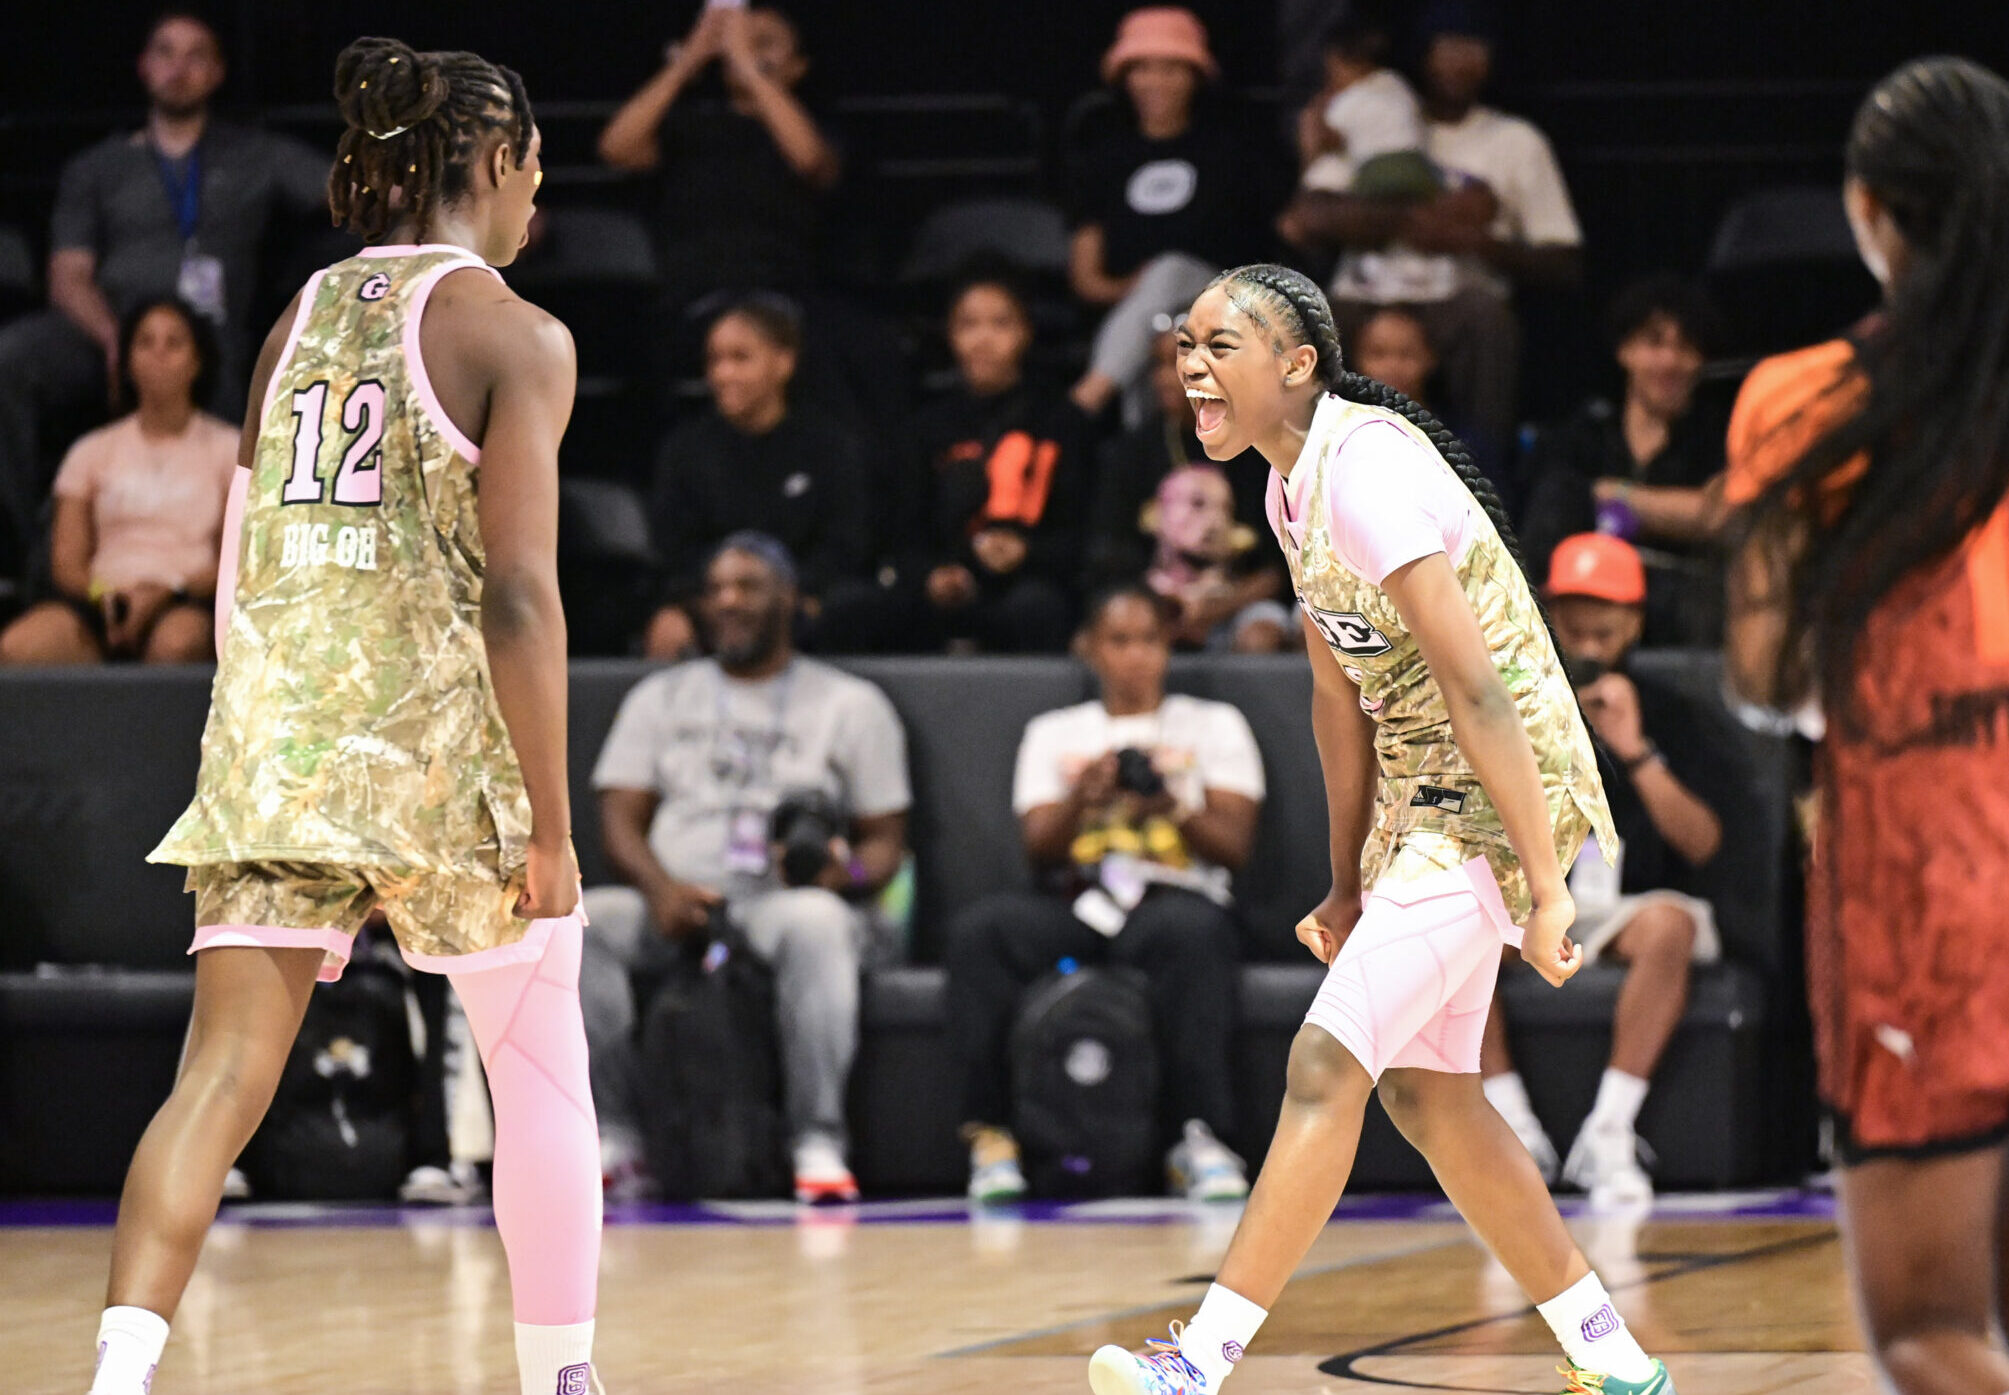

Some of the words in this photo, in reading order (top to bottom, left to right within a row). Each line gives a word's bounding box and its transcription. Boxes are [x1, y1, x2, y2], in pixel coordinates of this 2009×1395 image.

[280, 379, 385, 506] 12
[280, 523, 329, 567] BIG
[336, 526, 377, 570] OH
